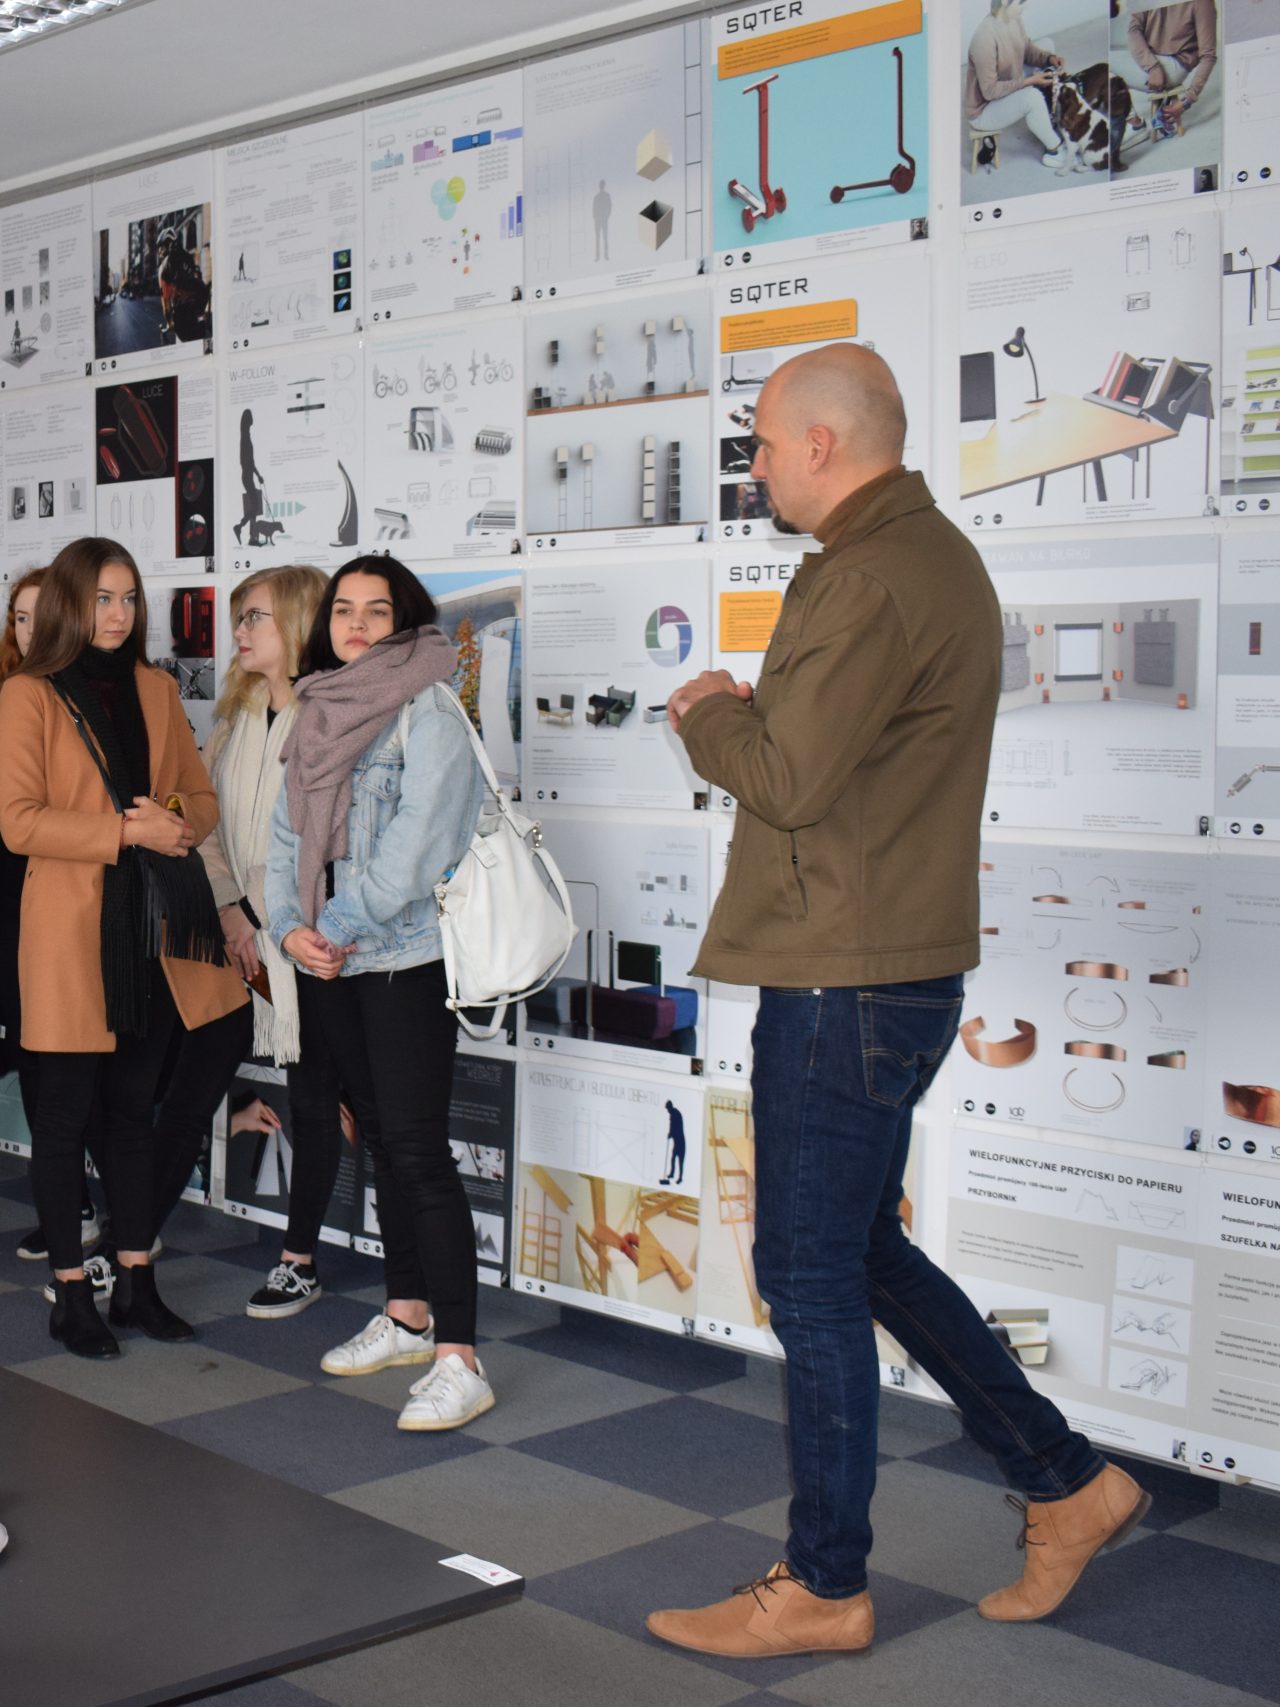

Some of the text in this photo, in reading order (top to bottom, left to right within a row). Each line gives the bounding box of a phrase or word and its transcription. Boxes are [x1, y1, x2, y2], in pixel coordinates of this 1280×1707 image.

[726, 0, 803, 34] SQTER
[729, 277, 809, 304] SQTER
[968, 1148, 1183, 1194] WIELOFUNKCYJNE PRZYCISKI DO PAPIERU
[967, 1186, 1017, 1202] PRZYBORNIK
[1220, 1233, 1268, 1249] SZUFELKA
